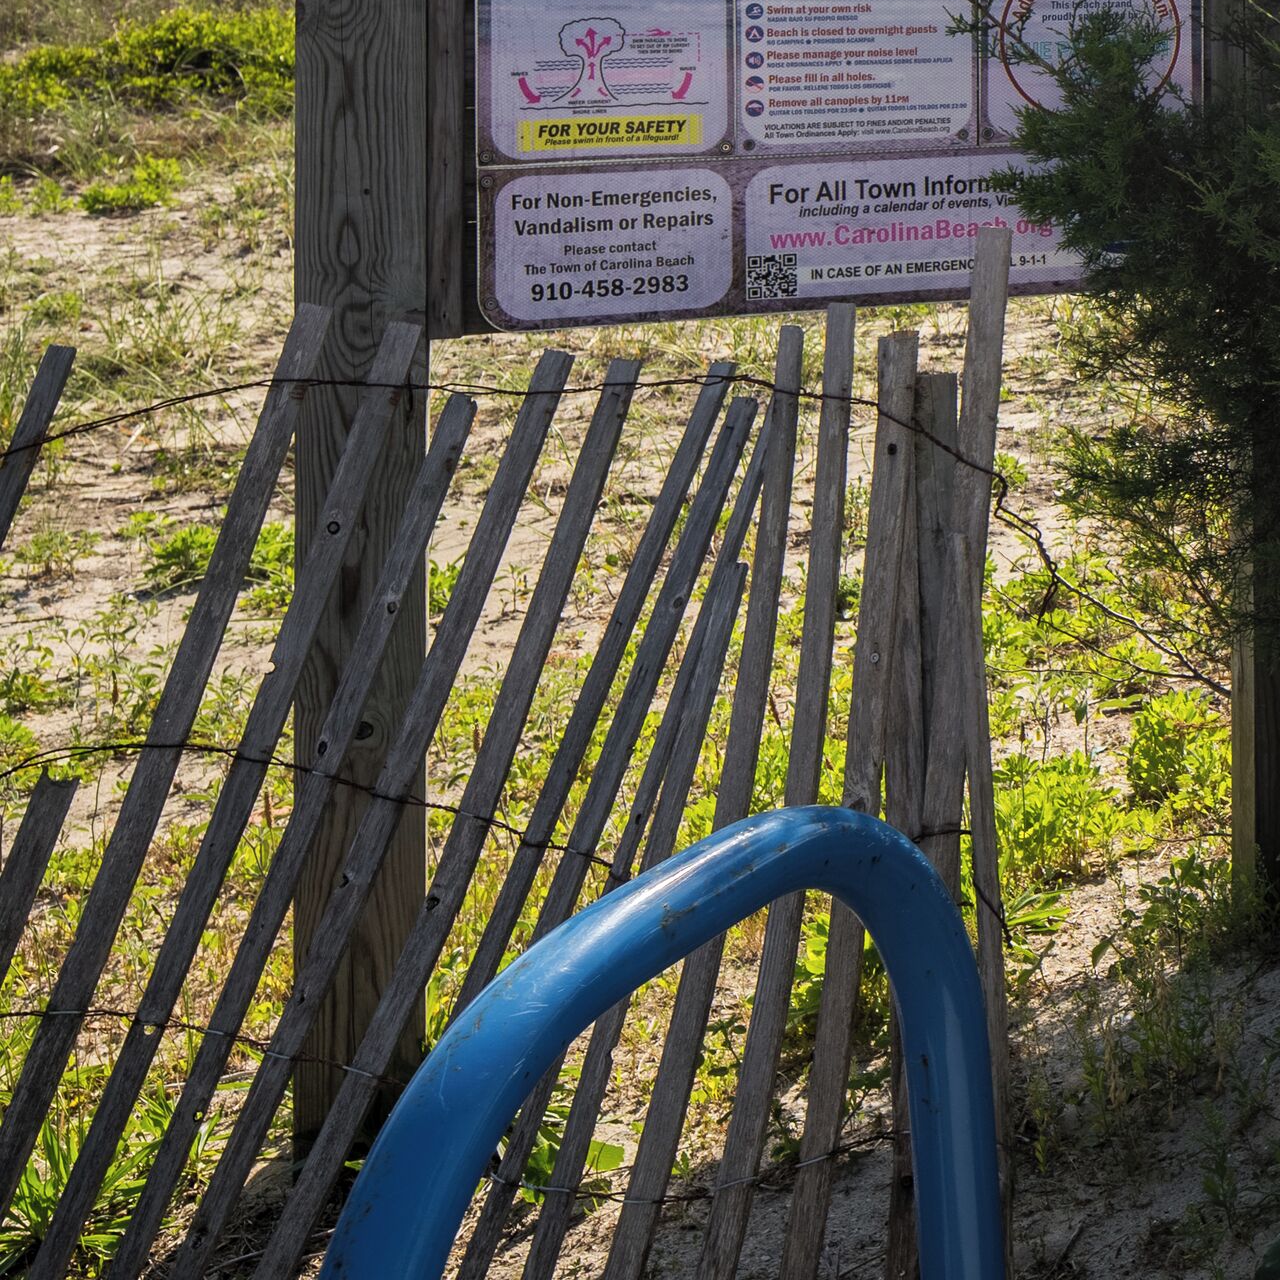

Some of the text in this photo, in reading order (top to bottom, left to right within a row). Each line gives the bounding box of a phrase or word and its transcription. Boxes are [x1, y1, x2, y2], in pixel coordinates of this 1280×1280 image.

[767, 5, 794, 14] Swim
[796, 5, 807, 13] at
[808, 6, 829, 15] your
[854, 4, 871, 12] risk
[1050, 0, 1132, 9] This strand
[766, 25, 937, 37] Beach is closed to overnight guests
[766, 47, 917, 60] Please manage your noise level
[769, 72, 876, 83] Please fill in all holes.
[769, 95, 909, 107] Remove all canopies by 11PM
[915, 117, 951, 125] PENALTIES
[538, 119, 687, 138] FOR YOUR SAFETY
[796, 130, 835, 138] Ordinances
[544, 137, 571, 146] Please
[605, 135, 621, 143] front
[511, 186, 717, 210] For Non-Emergencies,
[769, 179, 916, 205] For All Town
[799, 198, 991, 217] including a calendar of events,
[514, 211, 714, 236] Vandalism or Repairs
[564, 240, 657, 256] Please contact
[525, 255, 695, 276] The Town of Carolina Beach
[811, 255, 1046, 280] IN CASE OF AN 9-1-1
[531, 274, 689, 302] 910-458-2983
